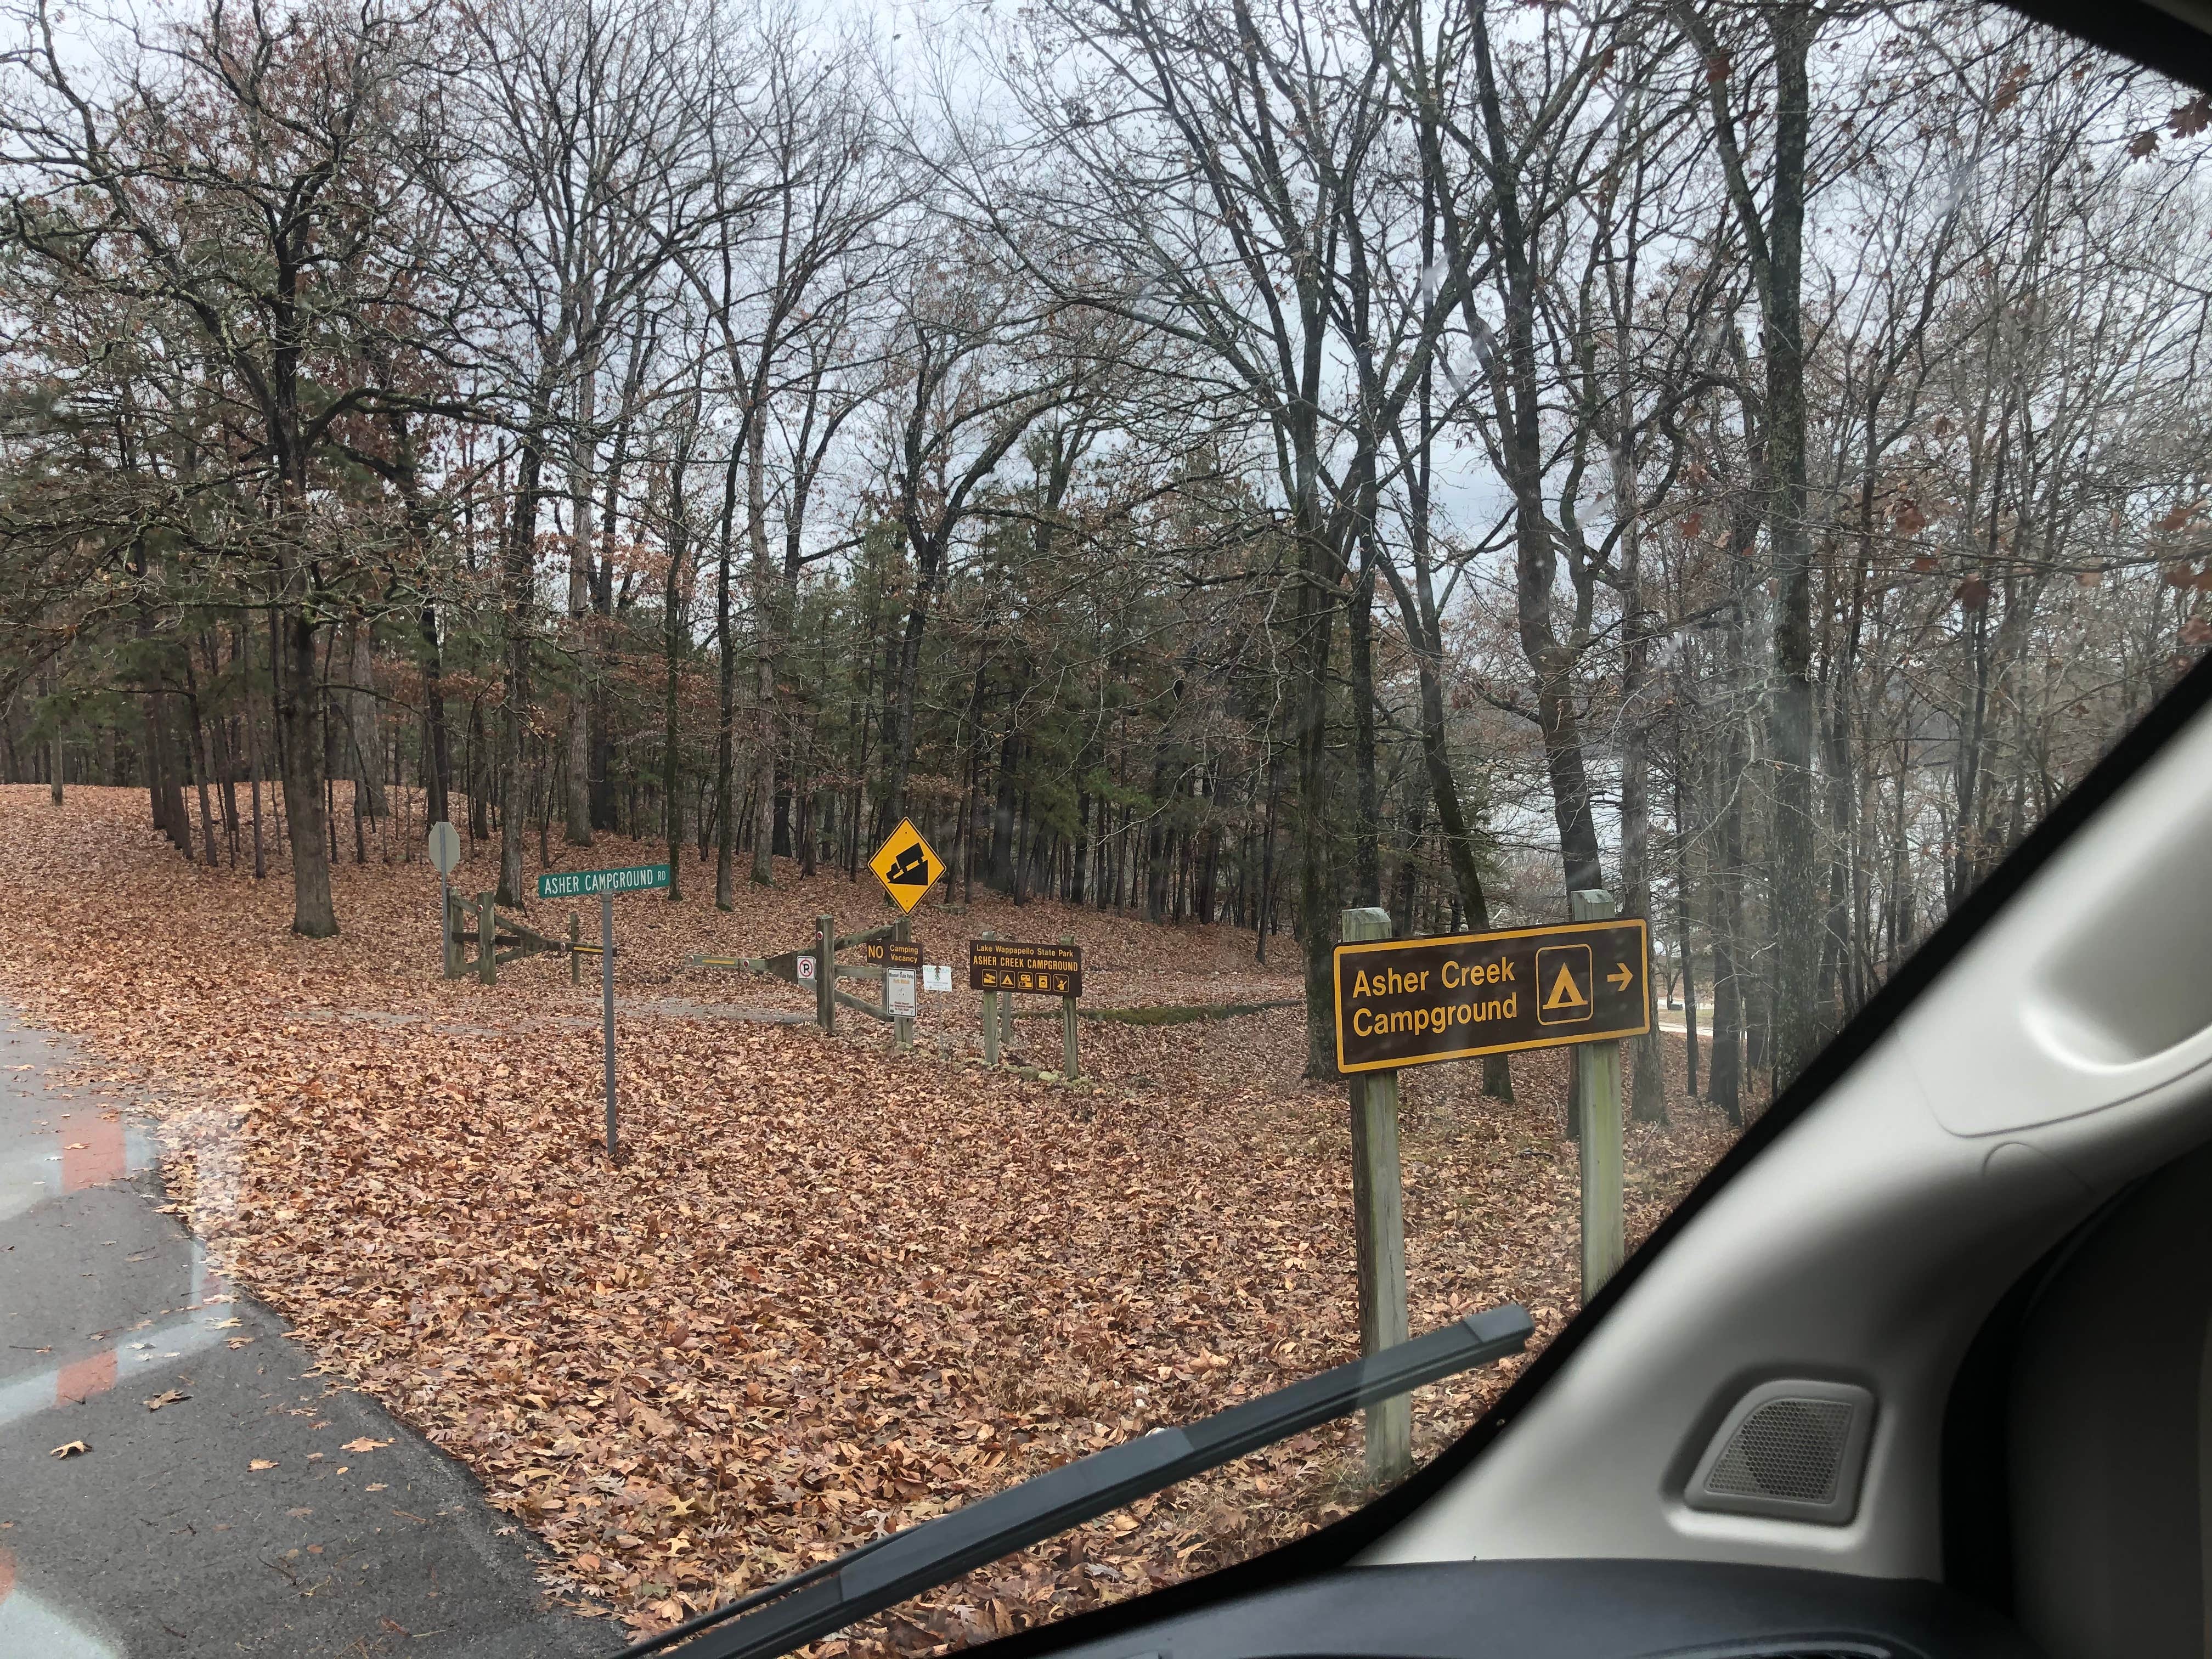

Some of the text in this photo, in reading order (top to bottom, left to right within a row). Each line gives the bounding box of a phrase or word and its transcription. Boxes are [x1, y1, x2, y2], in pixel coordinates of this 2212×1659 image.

[544, 869, 666, 895] ASHER CAMPGROUND RD
[868, 945, 884, 959] NO
[889, 944, 918, 955] Camping
[977, 944, 1074, 957] Lake Wappapello State Park
[890, 953, 918, 964] Vacancy
[973, 955, 1078, 972] ASHER CREEK CAMPGROUND
[1352, 956, 1515, 998] Asher Creek
[1353, 992, 1517, 1036] Campground
